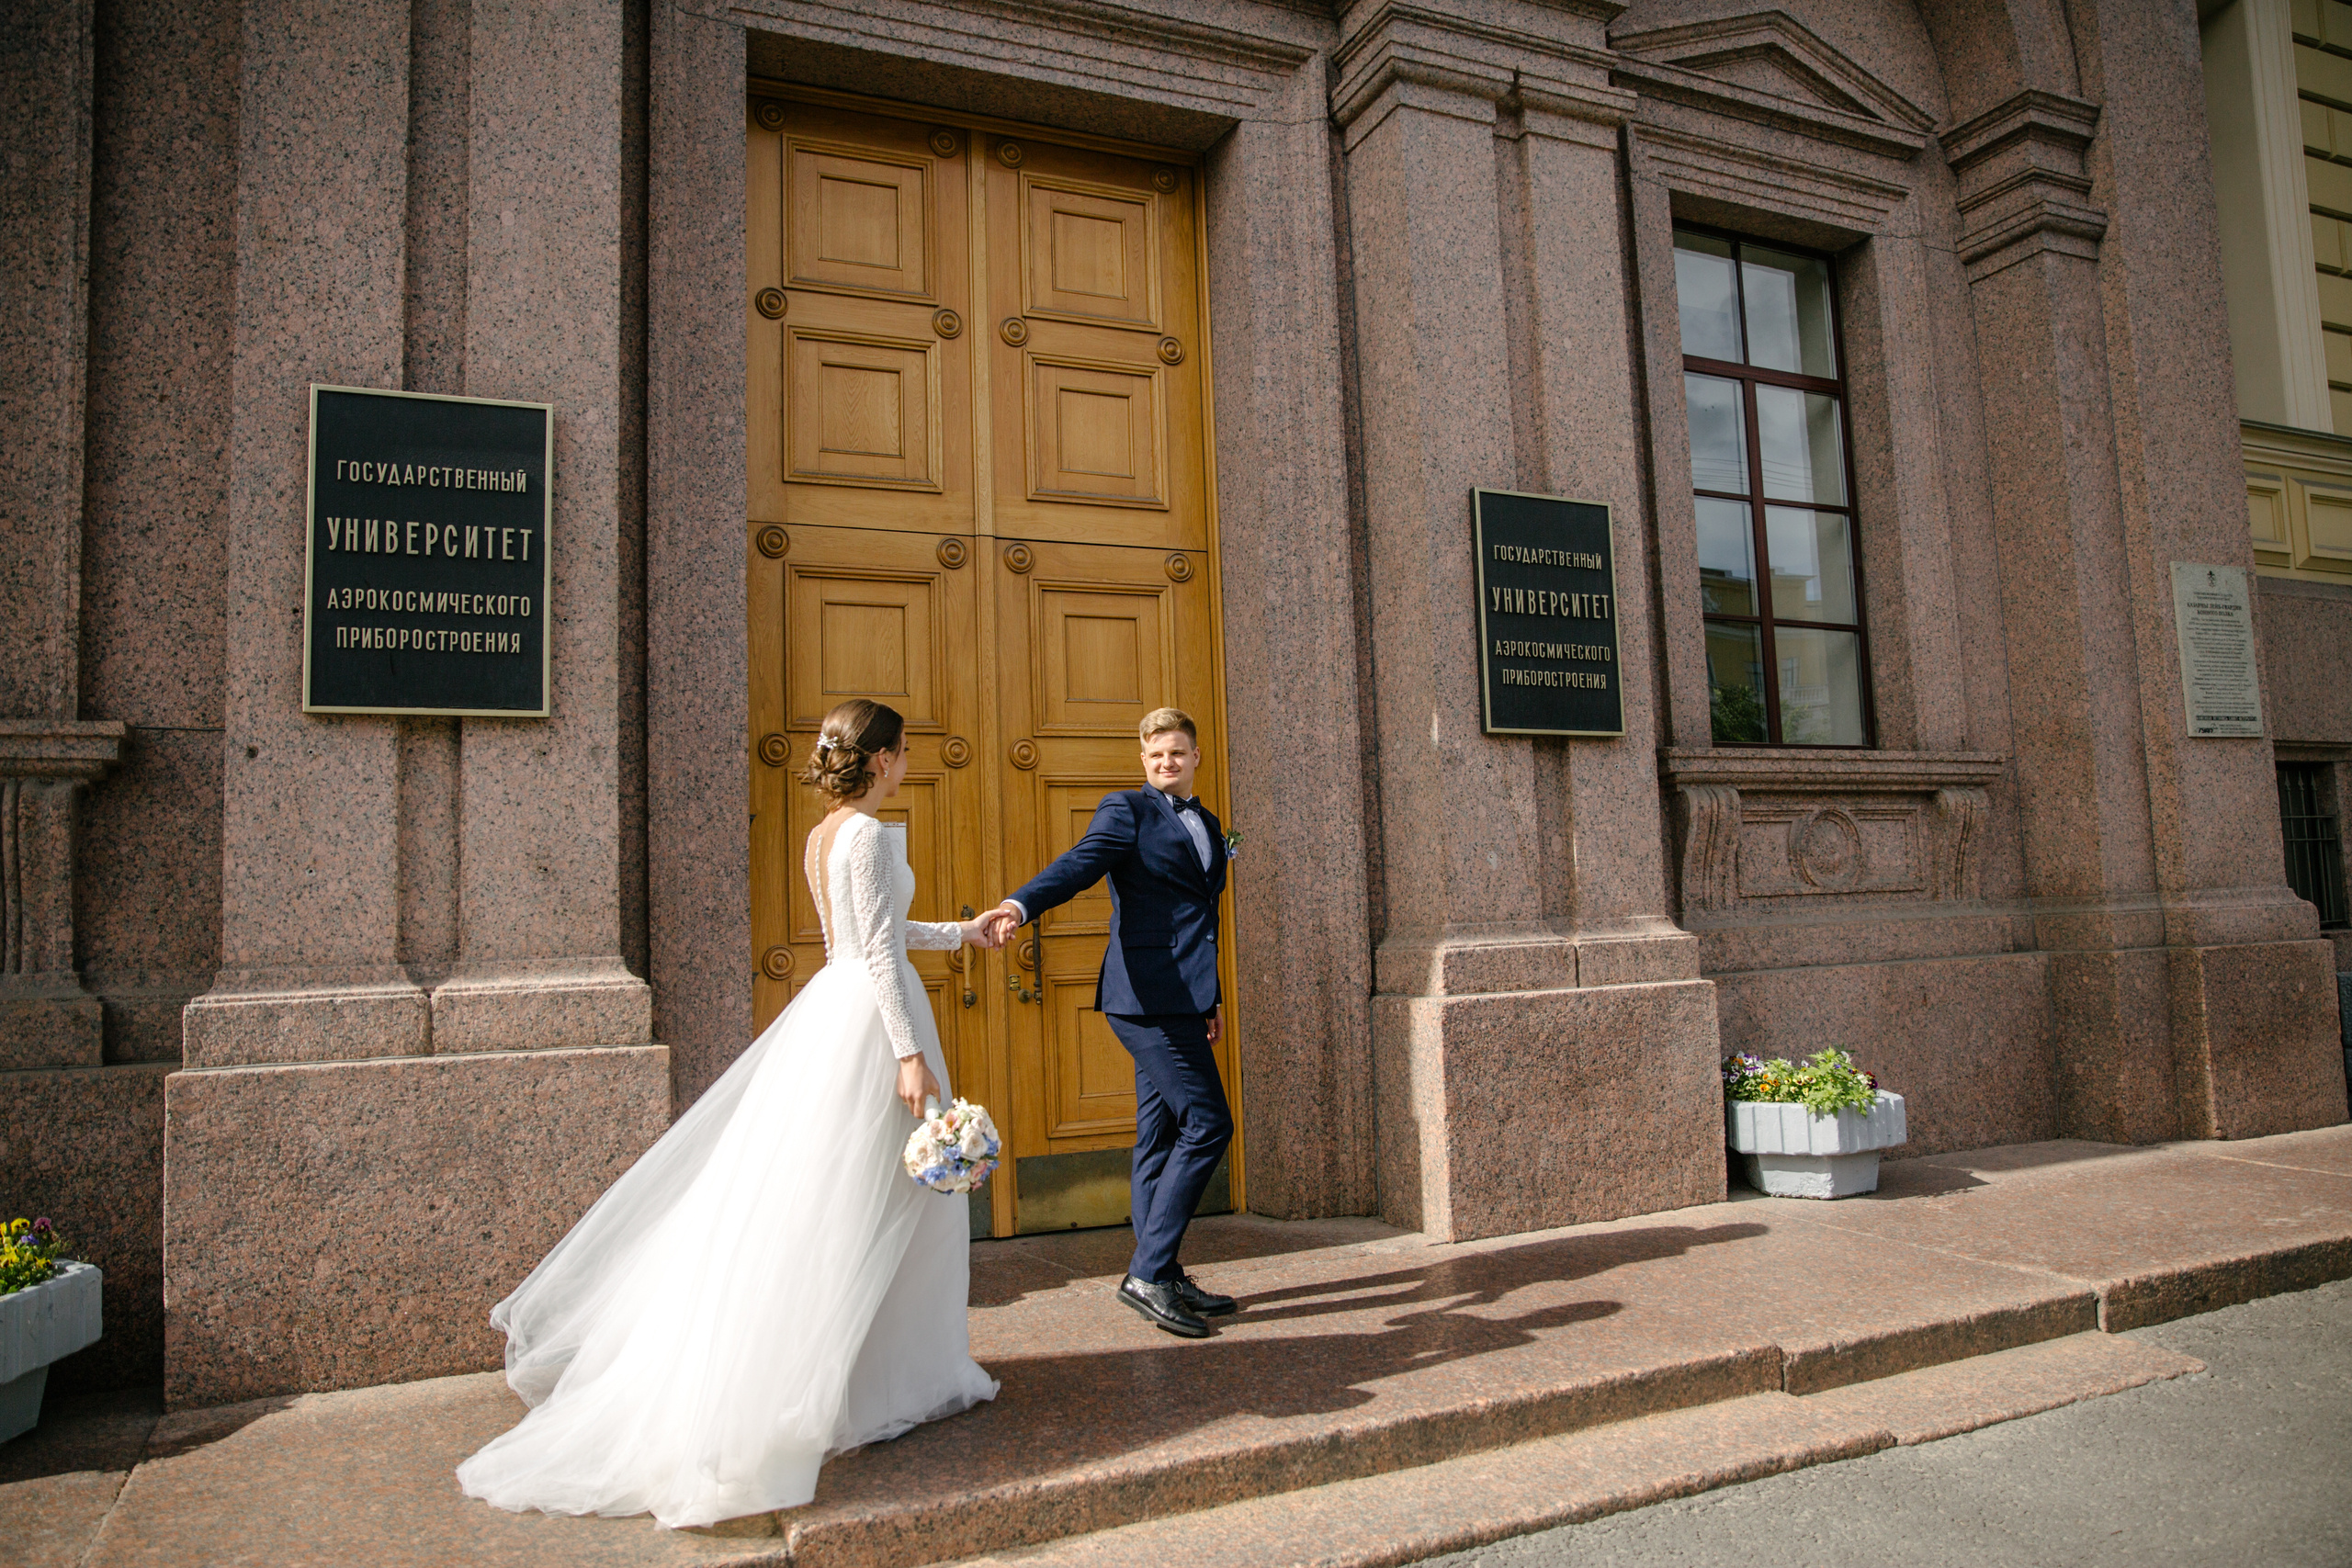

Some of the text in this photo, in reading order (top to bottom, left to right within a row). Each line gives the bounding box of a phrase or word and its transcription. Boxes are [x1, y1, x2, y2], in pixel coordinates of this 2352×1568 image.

[337, 459, 526, 492] ГОСУДАРСТВЕННЫЙ
[327, 516, 532, 561] УНИВЕРСИТЕТ
[1494, 544, 1602, 570] ГОСУДАРСТВЕННЫЙ
[327, 587, 531, 616] АЭРОКОСМИЧЕСКОГО
[1492, 586, 1609, 619] УНИВЕРСИТЕТ
[336, 626, 521, 653] ПРИБОРОСТРОЕНИЯ
[1495, 639, 1611, 661] АЭРОКОСМИЧЕСКОГО
[1502, 668, 1607, 690] ПРИБОРОСТРОЕНИЯ
